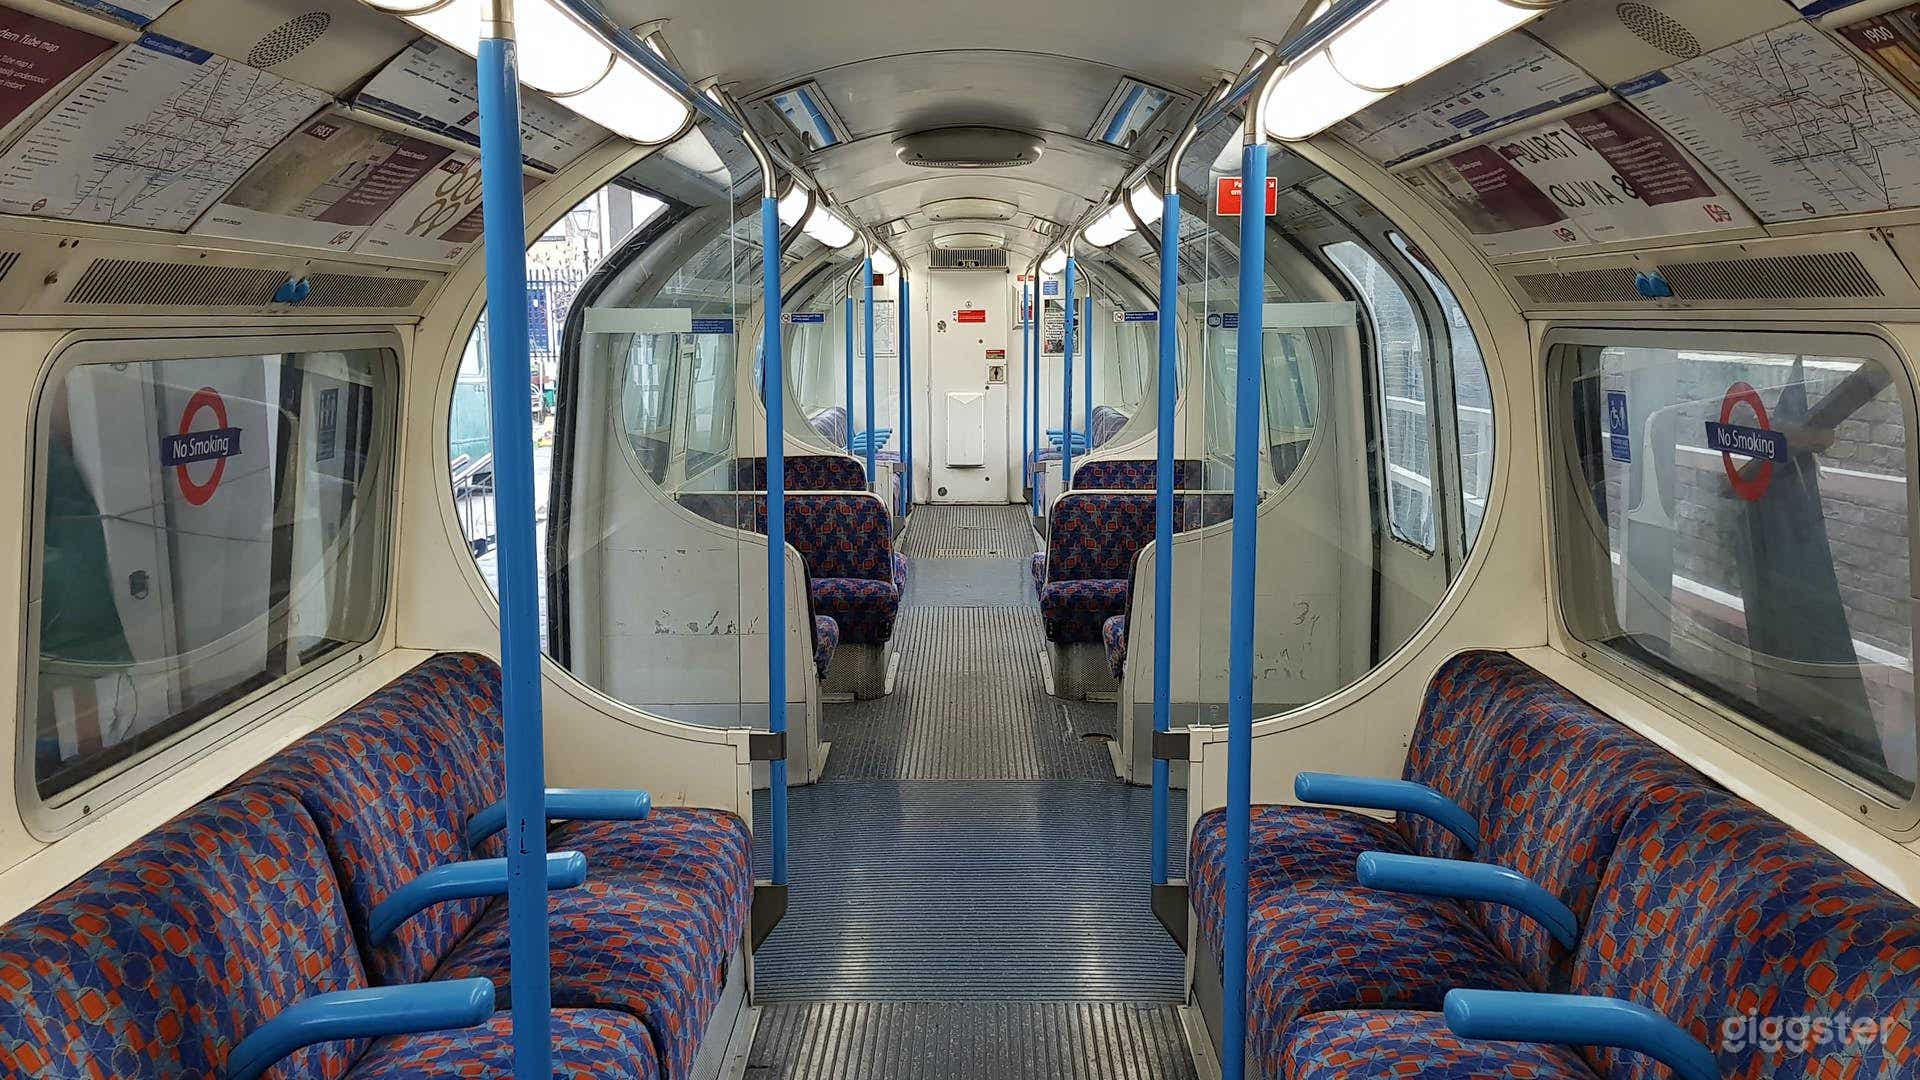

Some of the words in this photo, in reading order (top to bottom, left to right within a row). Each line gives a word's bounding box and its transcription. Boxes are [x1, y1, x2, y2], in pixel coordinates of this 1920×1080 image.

[19, 33, 42, 48] Tube
[39, 42, 60, 53] map
[1862, 25, 1894, 43] 1900
[172, 440, 187, 458] No
[188, 434, 230, 456] Smoking
[1717, 428, 1731, 446] No
[1733, 430, 1775, 459] Smoking
